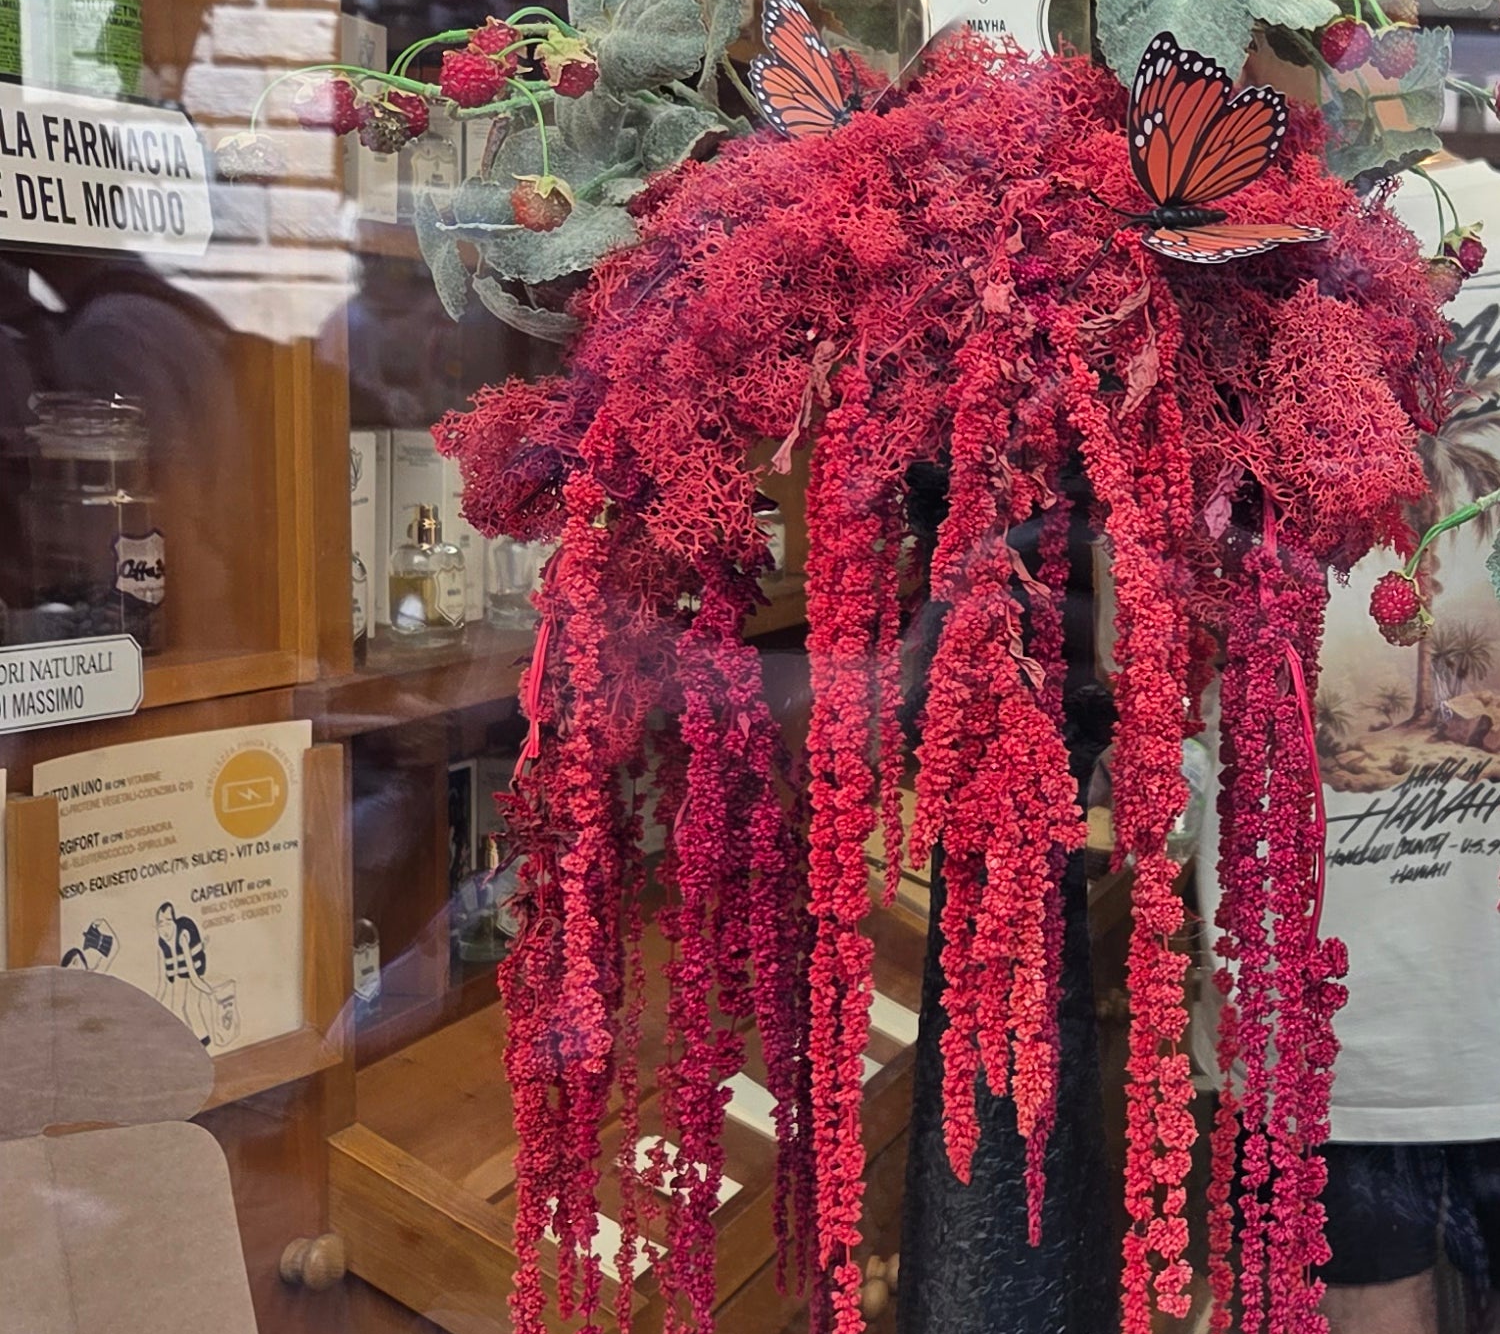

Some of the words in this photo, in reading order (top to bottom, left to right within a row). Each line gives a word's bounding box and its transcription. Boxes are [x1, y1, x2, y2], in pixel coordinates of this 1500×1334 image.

[967, 19, 1006, 33] MAYHA
[42, 114, 191, 179] FARMACIA
[15, 172, 77, 225] DEL
[82, 180, 185, 235] MONDO
[30, 651, 113, 683] NATURALI
[13, 684, 84, 718] MASSIMO
[81, 777, 103, 796] UNO
[88, 867, 139, 892] EQUISETO
[236, 842, 253, 859] VIT
[190, 878, 245, 903] CAPELVIT
